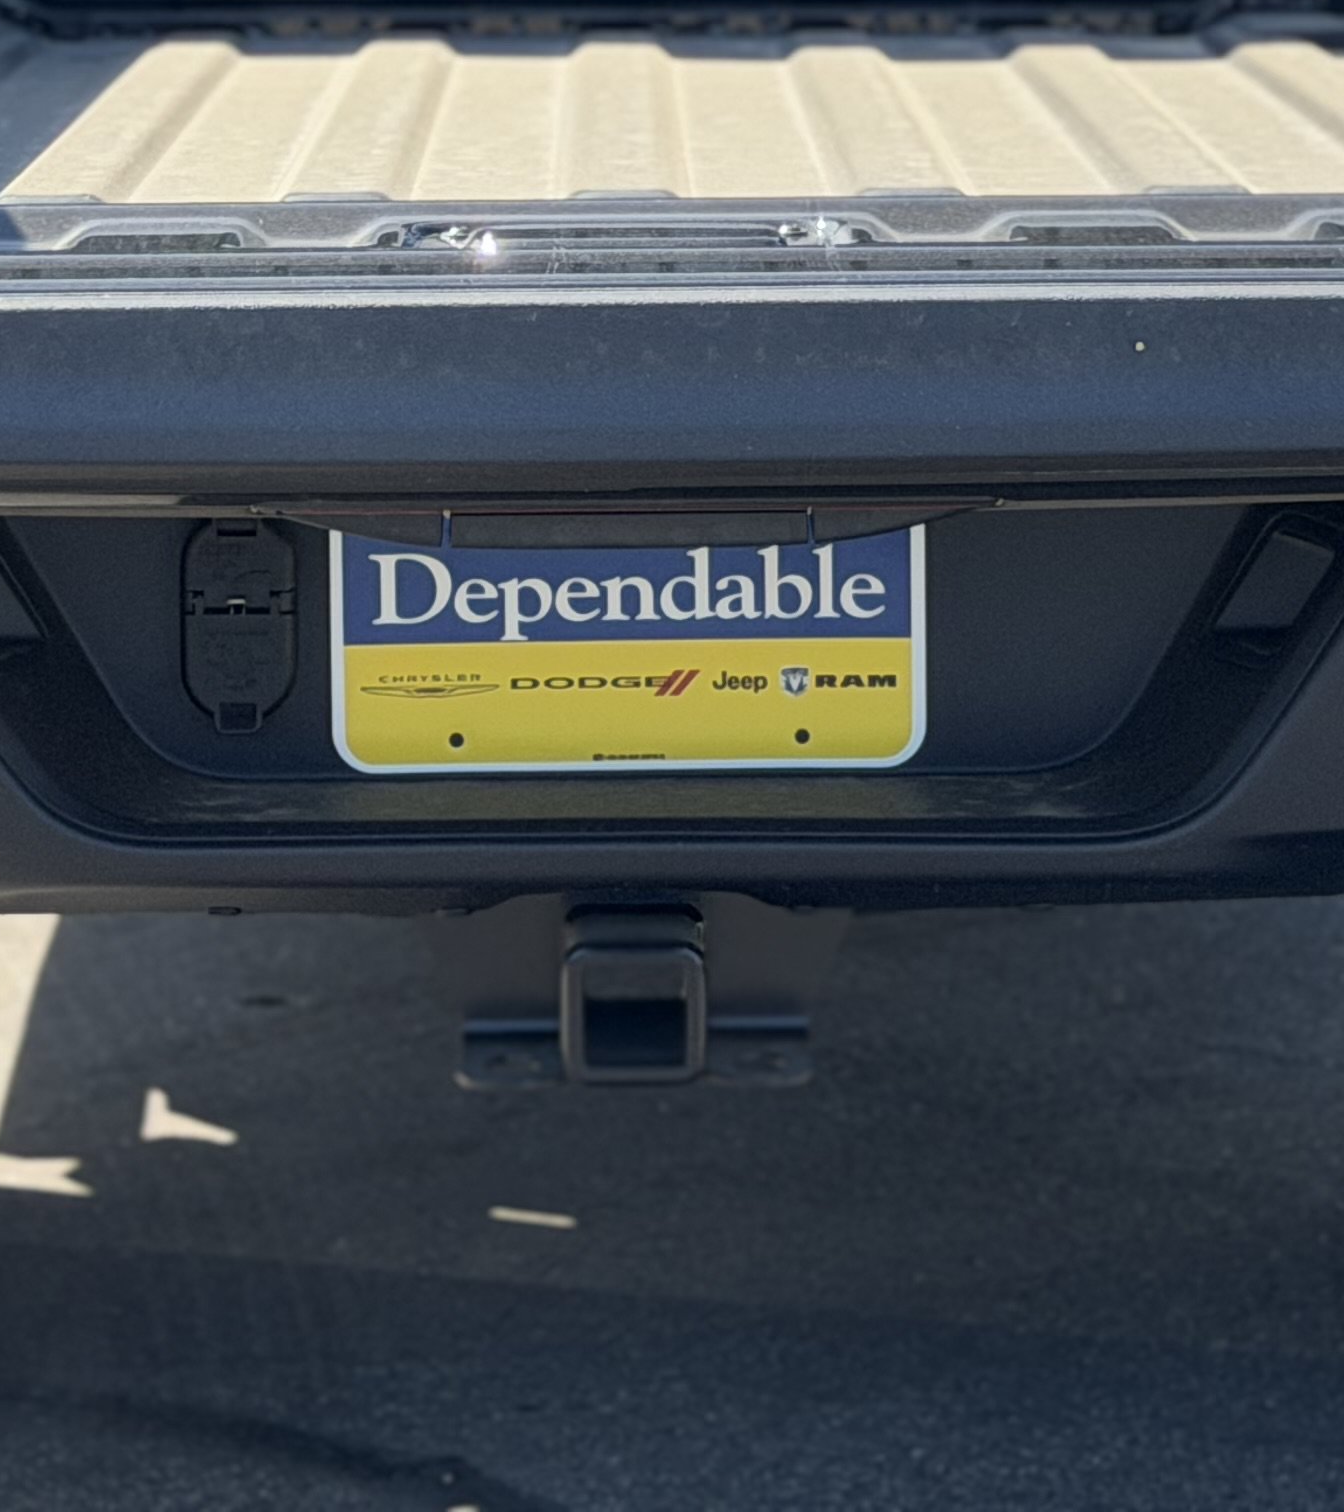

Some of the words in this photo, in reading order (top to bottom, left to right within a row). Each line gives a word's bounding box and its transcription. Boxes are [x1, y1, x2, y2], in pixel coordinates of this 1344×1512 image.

[368, 543, 886, 641] Dependable
[378, 673, 482, 685] CHRYSLER
[511, 674, 676, 690] DODGE
[712, 670, 768, 694] Jeep
[815, 674, 897, 688] RAM
